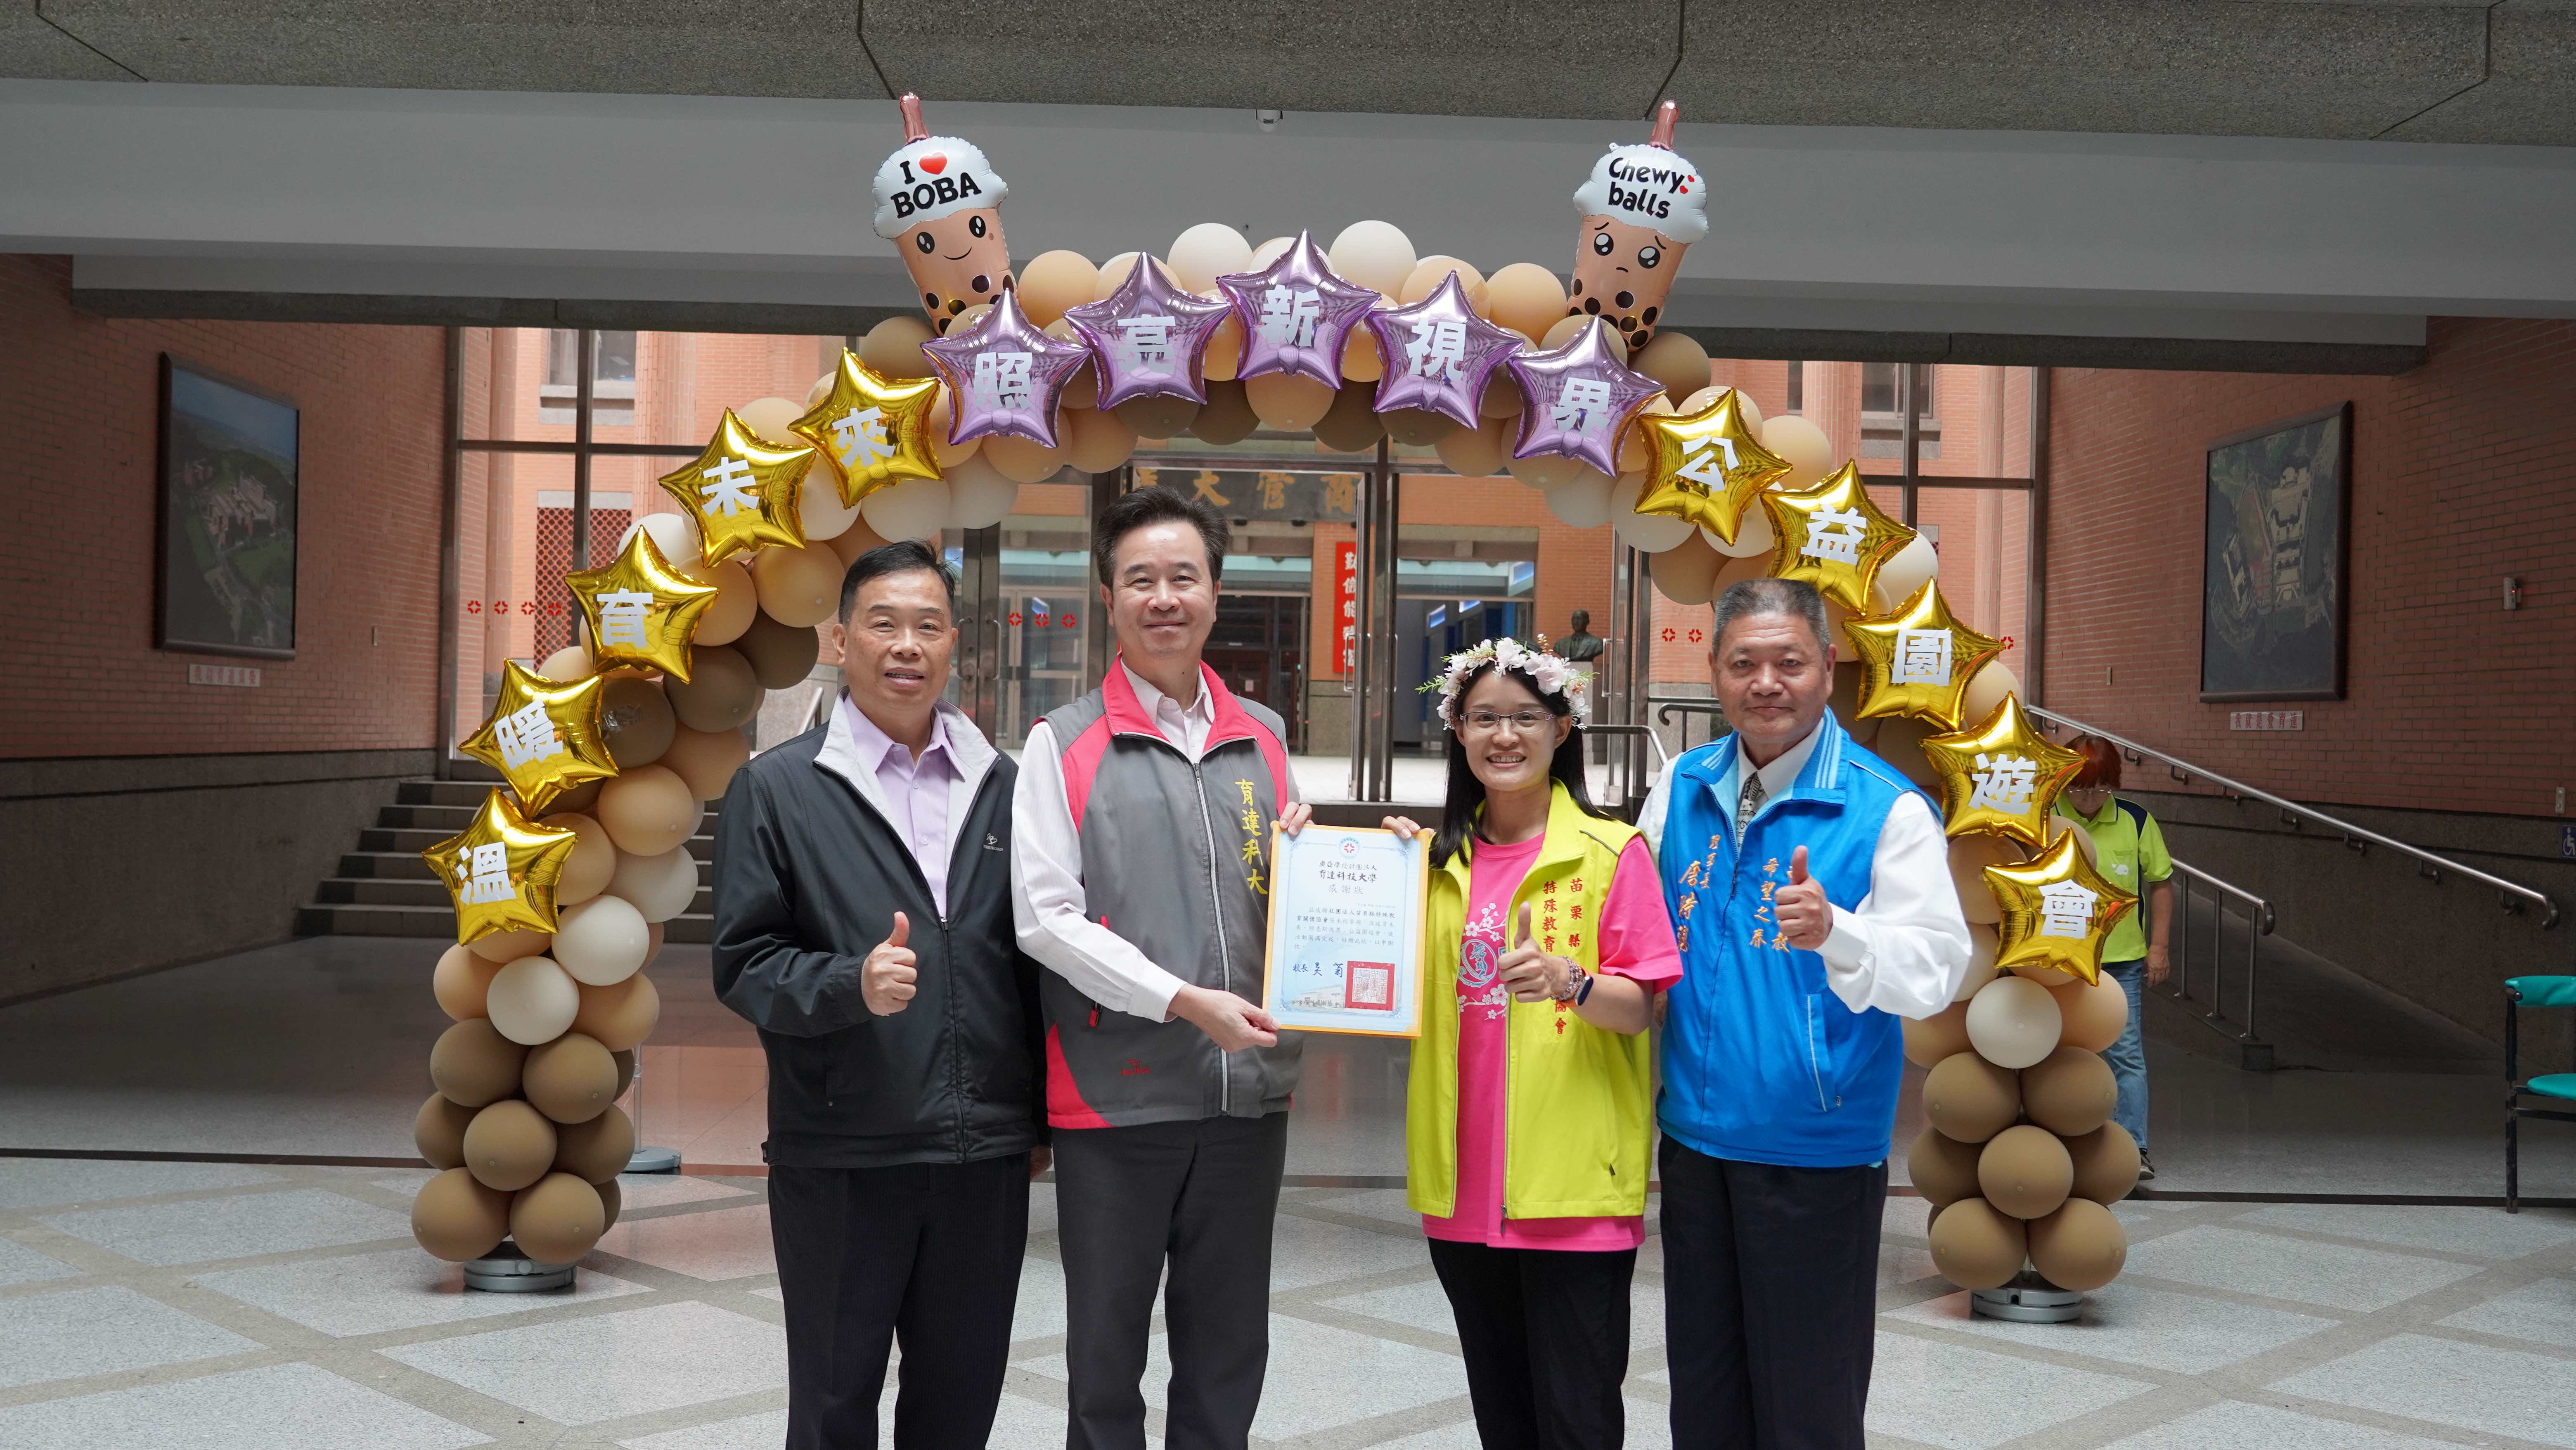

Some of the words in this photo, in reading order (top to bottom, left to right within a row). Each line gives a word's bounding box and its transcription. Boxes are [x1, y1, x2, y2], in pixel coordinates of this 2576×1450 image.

[900, 161, 915, 185] I
[1608, 157, 1685, 194] Chewy
[890, 172, 982, 219] BOBA
[1608, 182, 1671, 219] balls
[1235, 778, 1268, 895] 育達科大
[1319, 870, 1377, 883] 育達科技大學
[1328, 884, 1363, 894] 感謝狀
[1568, 878, 1583, 948] 苗栗縣
